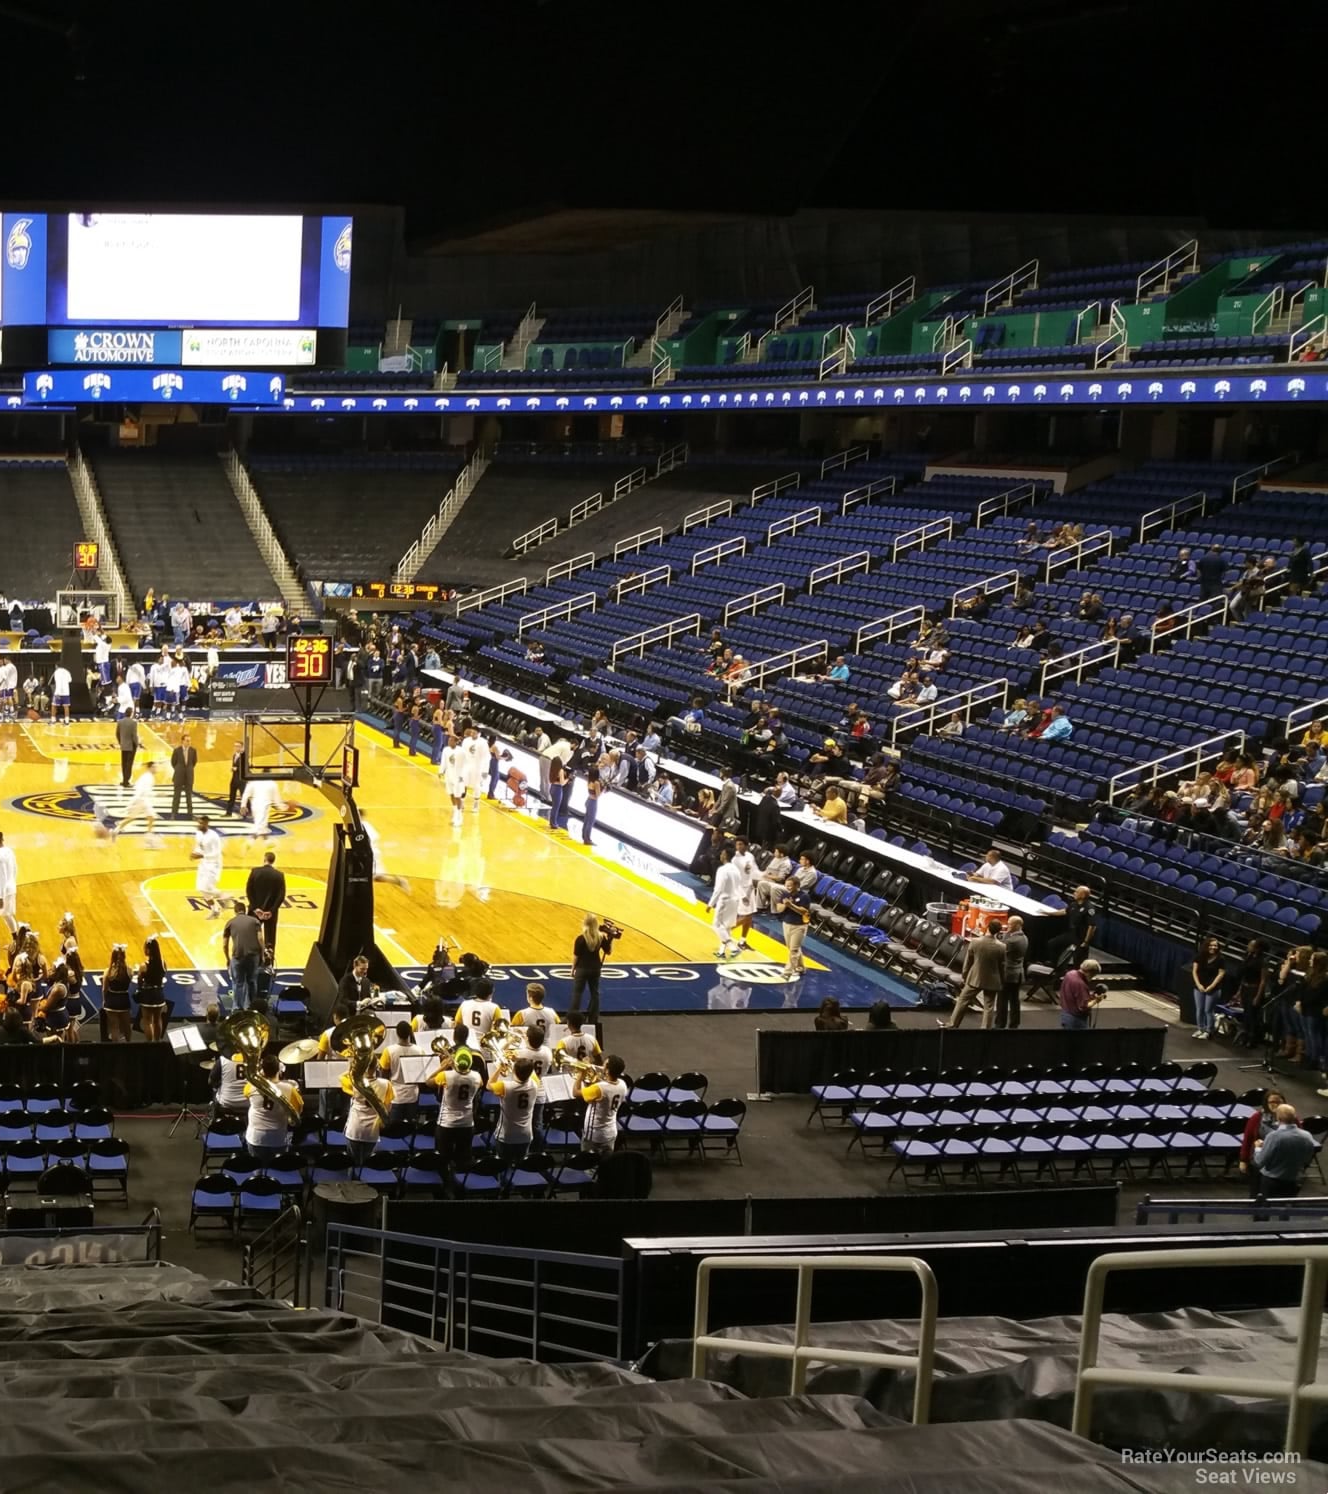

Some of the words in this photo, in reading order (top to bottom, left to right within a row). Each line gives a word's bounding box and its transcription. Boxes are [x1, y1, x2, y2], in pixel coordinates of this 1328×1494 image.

[90, 332, 155, 348] CROWN
[74, 350, 154, 362] AUTOMOTIVE
[295, 639, 329, 653] 12:36
[297, 654, 323, 677] 30
[471, 1010, 481, 1026] 6
[458, 1084, 470, 1101] 6
[517, 1092, 529, 1110] 6
[611, 1094, 621, 1111] 6
